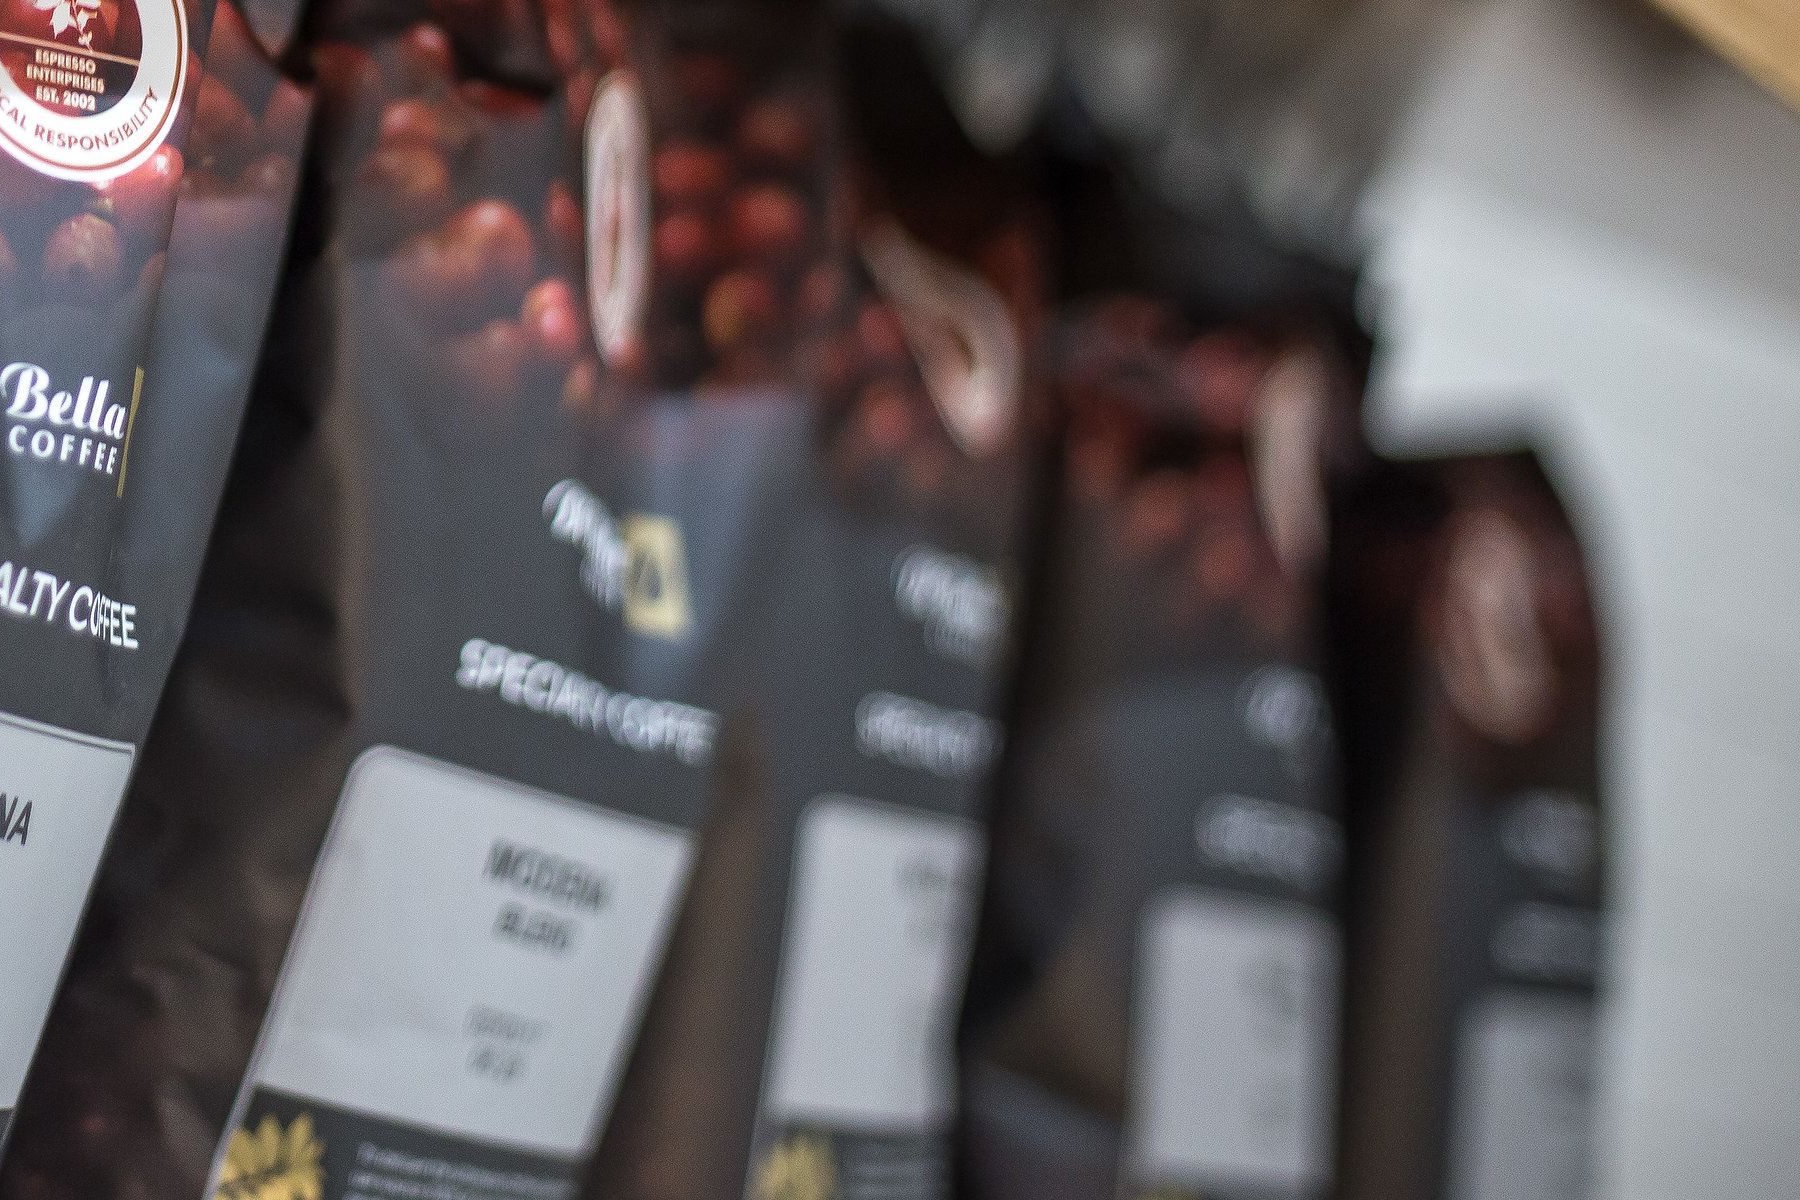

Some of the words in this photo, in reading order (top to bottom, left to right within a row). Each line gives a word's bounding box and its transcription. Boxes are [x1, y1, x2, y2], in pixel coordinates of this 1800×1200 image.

[34, 85, 160, 150] RESPONSIBILITY
[0, 361, 128, 441] Bella
[8, 424, 119, 476] COFFEE
